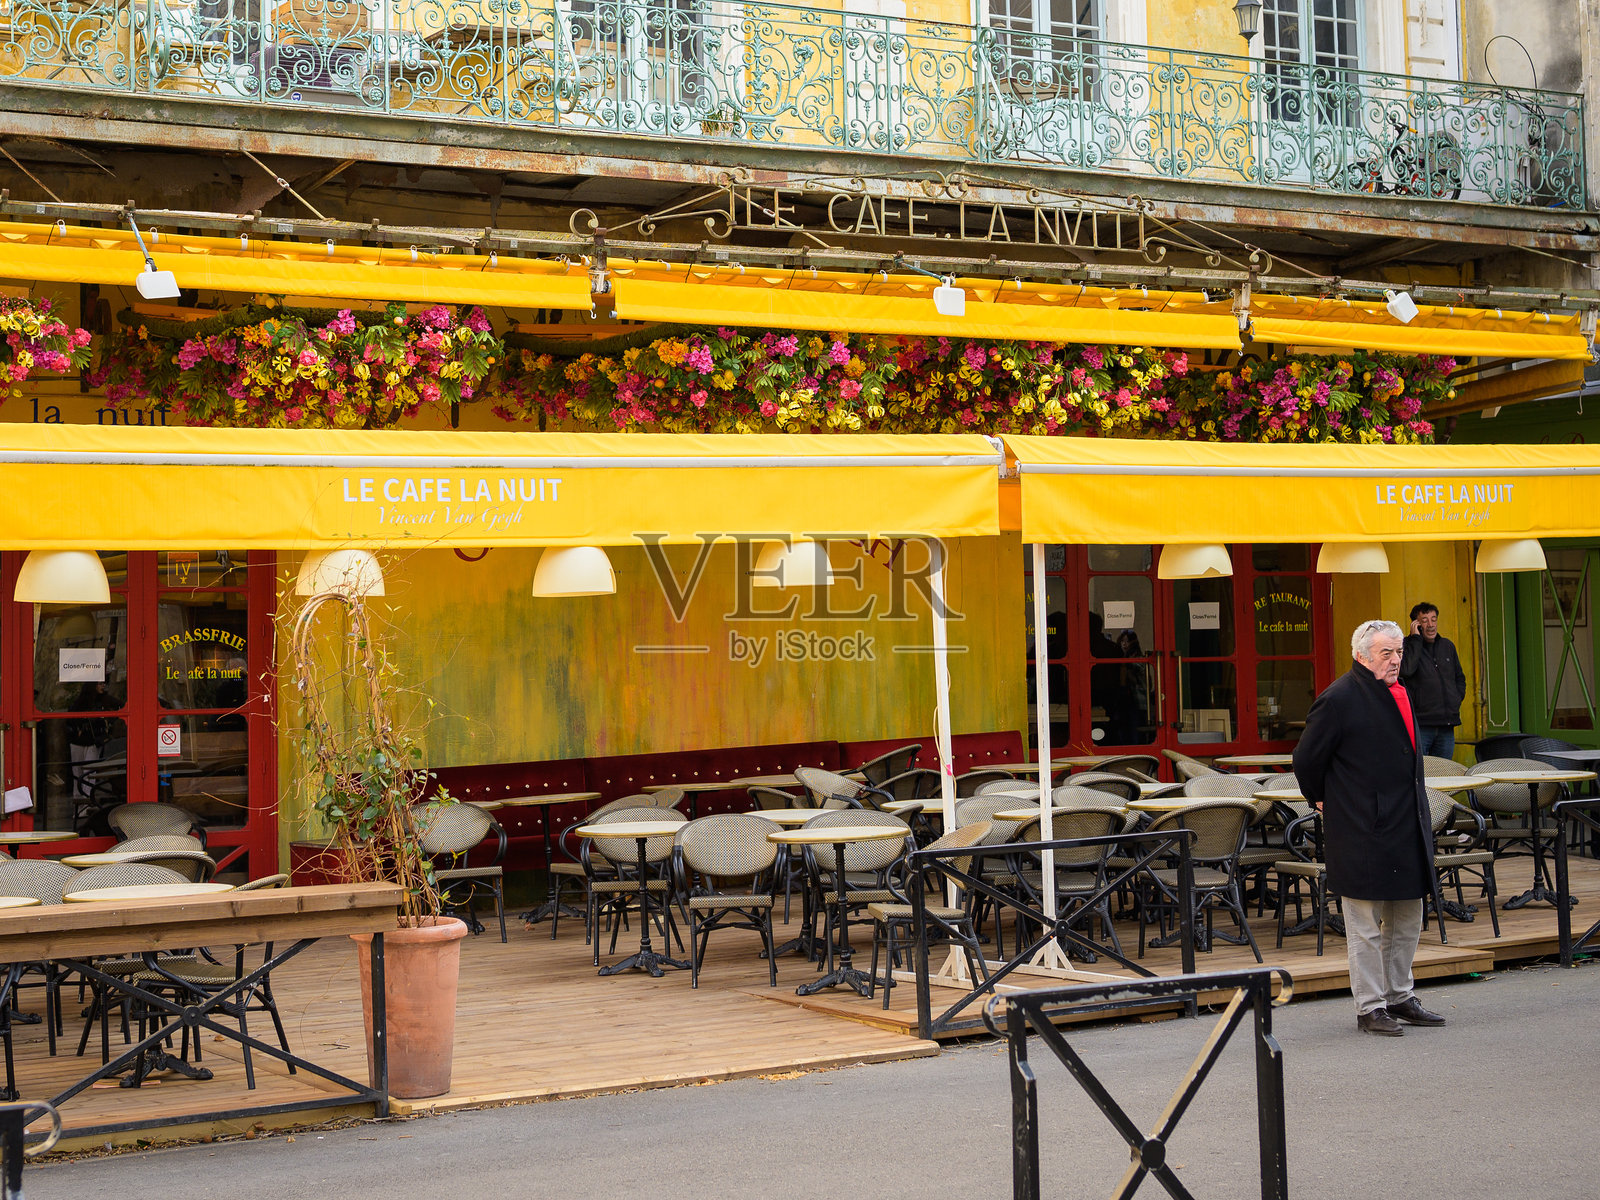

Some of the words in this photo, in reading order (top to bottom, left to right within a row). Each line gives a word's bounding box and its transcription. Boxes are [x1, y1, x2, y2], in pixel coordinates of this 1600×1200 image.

[746, 185, 804, 229] LE
[959, 200, 1011, 242] LA
[29, 398, 64, 424] la
[342, 477, 375, 503] LE
[382, 477, 451, 503] CAFE
[459, 477, 493, 503] LA
[499, 477, 563, 503] NUIT
[1375, 484, 1397, 504] LE
[1401, 484, 1445, 504] CAFE
[1449, 484, 1471, 504] LA
[1473, 483, 1515, 503] NUIT
[377, 504, 437, 525] Vincent
[444, 504, 475, 525] Van
[480, 500, 526, 533] Gogh
[1399, 505, 1437, 522] Vincent
[1440, 504, 1461, 521] Van
[1463, 501, 1493, 528] Gogh
[1259, 621, 1268, 632] Le
[1285, 621, 1293, 632] la
[1294, 620, 1309, 632] nuit
[62, 662, 102, 670] Close/Fermé
[166, 666, 180, 680] Le
[207, 666, 217, 679] la
